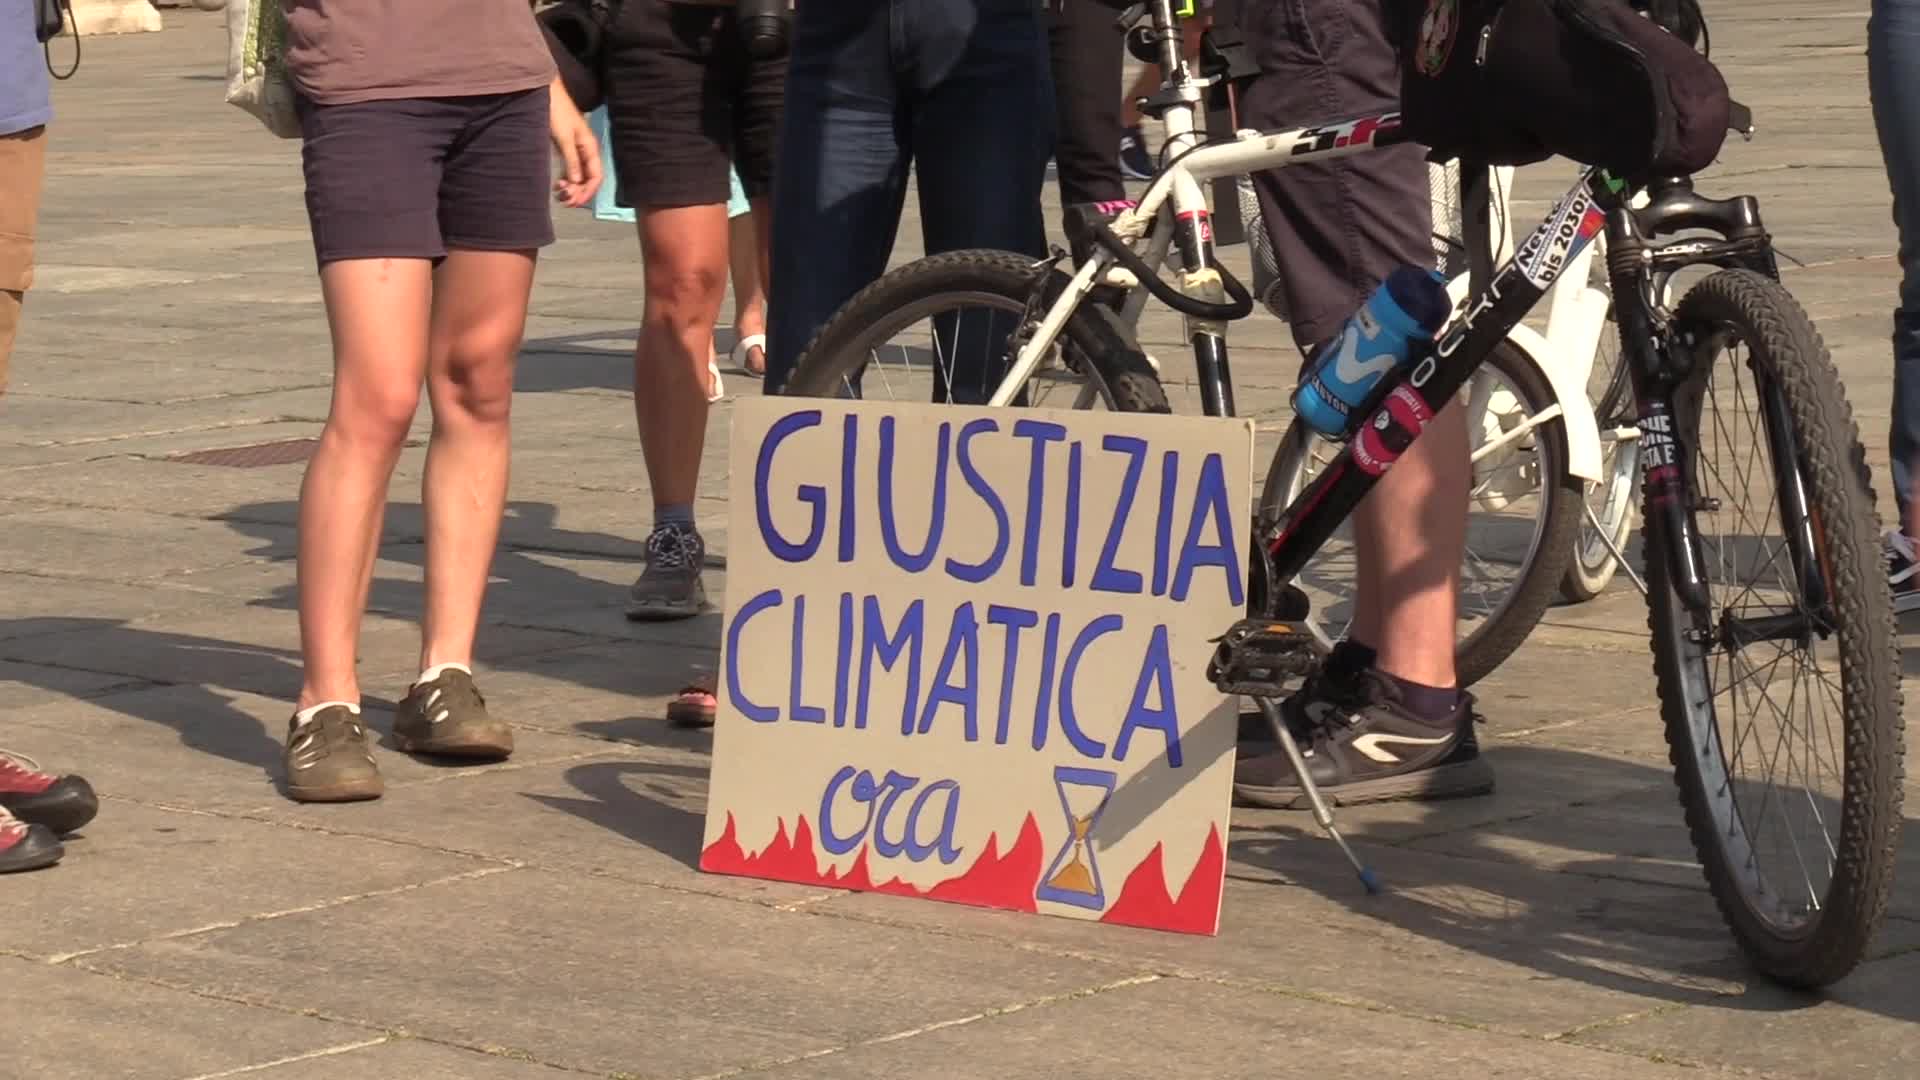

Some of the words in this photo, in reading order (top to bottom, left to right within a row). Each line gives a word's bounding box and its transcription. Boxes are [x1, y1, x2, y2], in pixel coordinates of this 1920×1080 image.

[1538, 254, 1562, 282] bis
[1554, 192, 1589, 251] 2030!
[754, 409, 1244, 606] GIUSTIZIA
[726, 588, 1183, 768] CLIMATICA
[818, 765, 964, 864] ora
